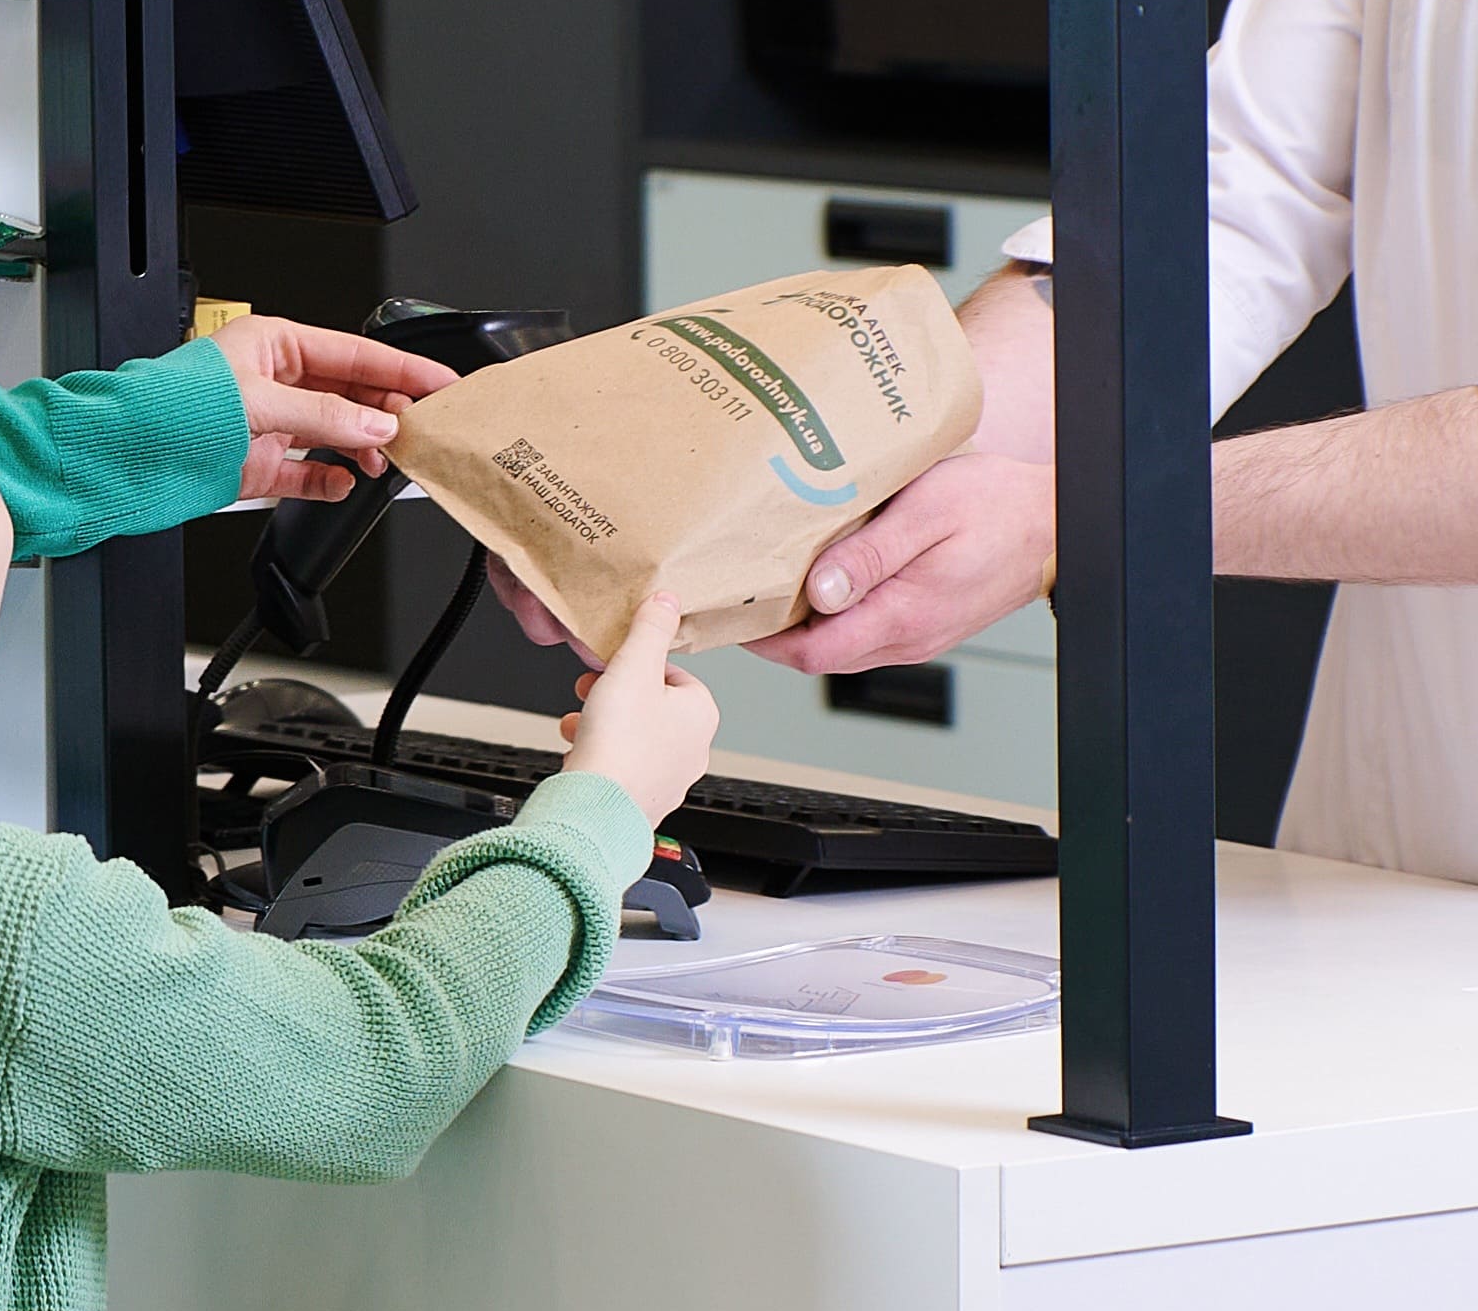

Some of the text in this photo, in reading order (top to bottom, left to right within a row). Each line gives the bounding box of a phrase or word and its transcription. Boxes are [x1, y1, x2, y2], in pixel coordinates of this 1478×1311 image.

[646, 337, 753, 423] 0 800 303 111
[673, 317, 825, 456] www.podorozhnyk.ua
[796, 294, 913, 424] ПОДОРОЖНИК
[864, 318, 907, 377] АПТЕК
[521, 472, 600, 545] НАШ ДОДАТОК
[535, 463, 618, 538] ЗАВАНТАЖУЙТЕ
